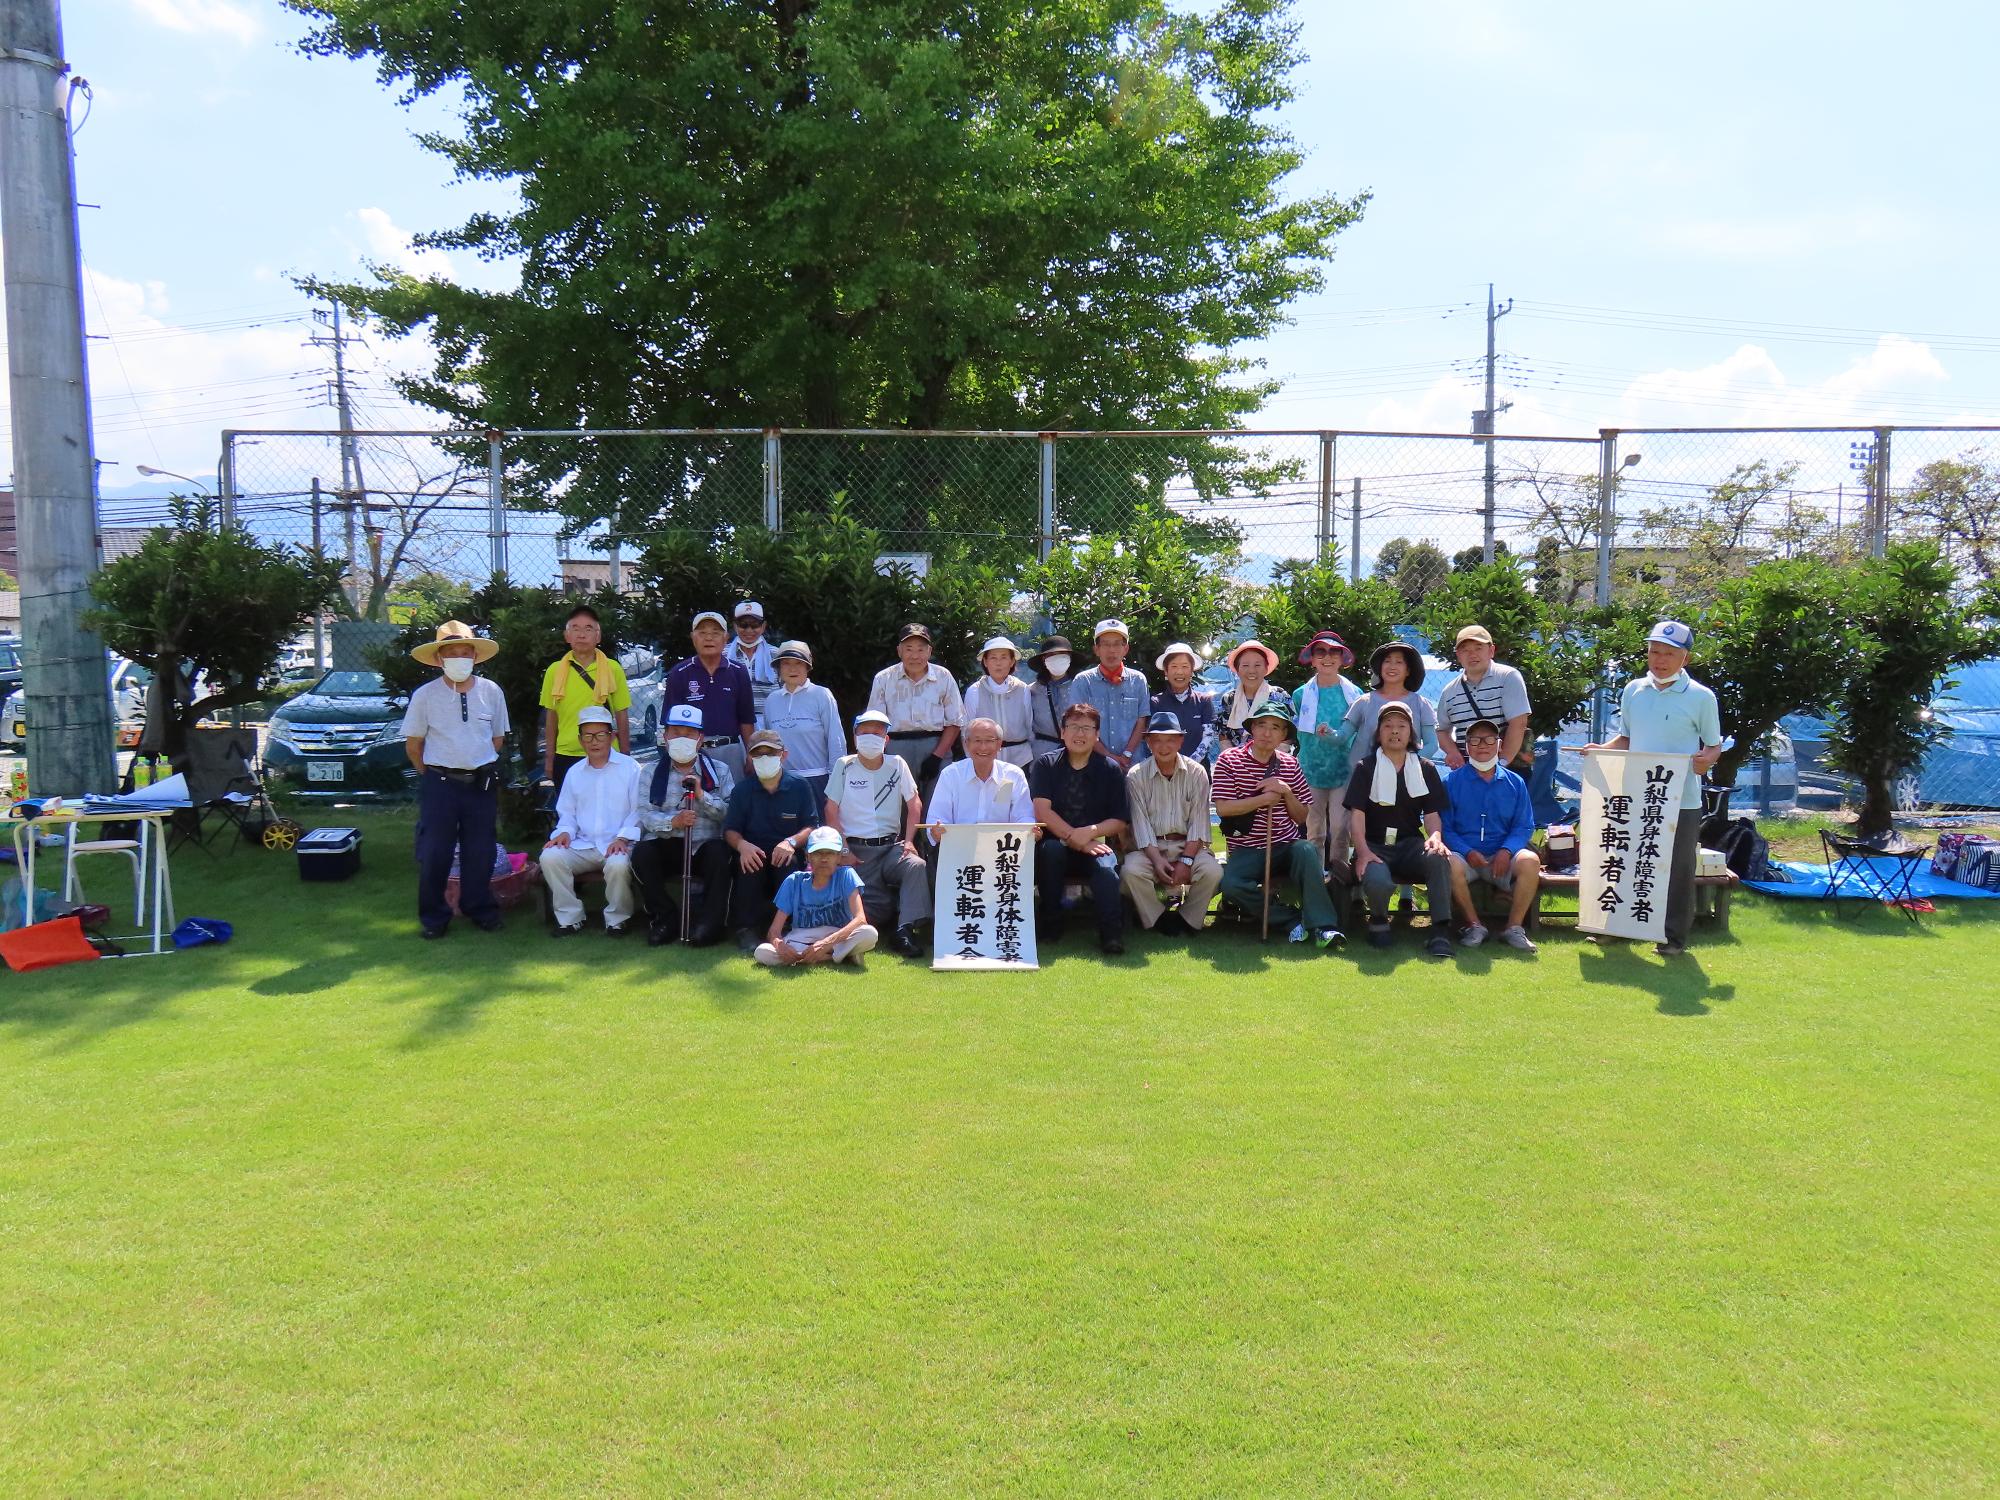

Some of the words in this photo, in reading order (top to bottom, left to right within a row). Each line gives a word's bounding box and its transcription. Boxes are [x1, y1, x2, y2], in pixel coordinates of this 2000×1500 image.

[1597, 795, 1633, 914] 運転者会
[1630, 765, 1674, 923] 山梨県身体障害者
